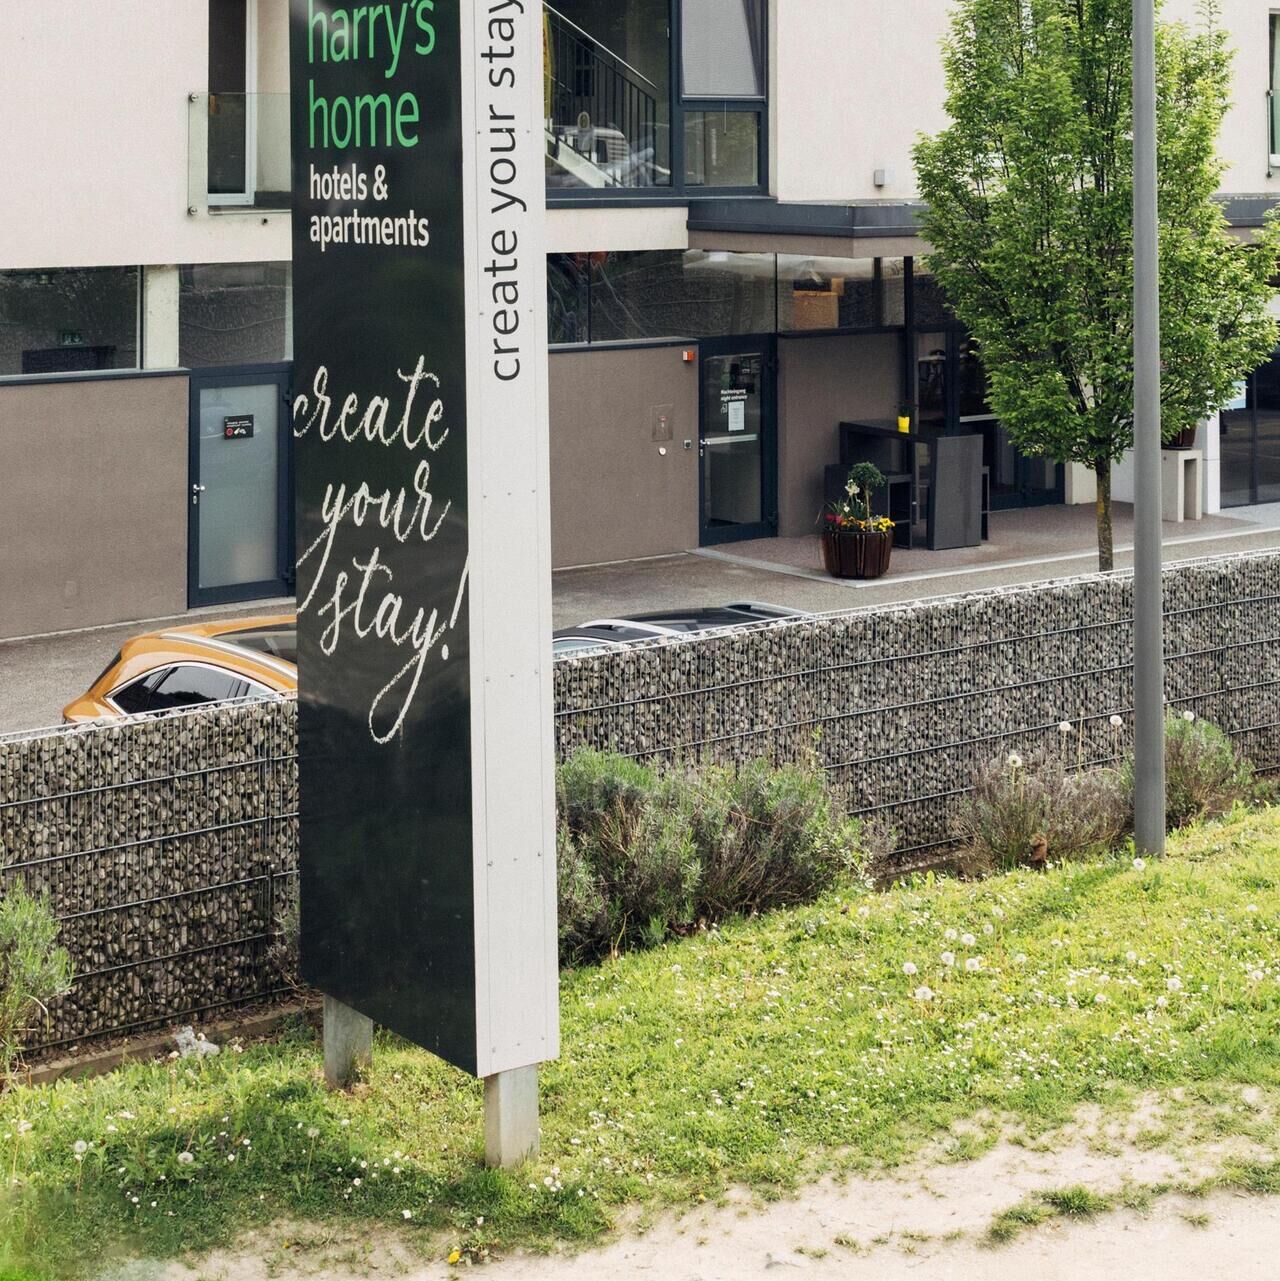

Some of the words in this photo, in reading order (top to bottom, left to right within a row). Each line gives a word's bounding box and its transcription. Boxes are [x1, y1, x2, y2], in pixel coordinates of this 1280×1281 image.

[308, 79, 420, 150] home
[488, 104, 527, 214] your
[309, 163, 368, 201] hotels
[372, 164, 389, 201] &
[309, 208, 430, 252] apartments
[483, 229, 521, 382] create
[293, 355, 449, 451] create
[296, 460, 451, 614] your
[318, 547, 470, 744] stay!
